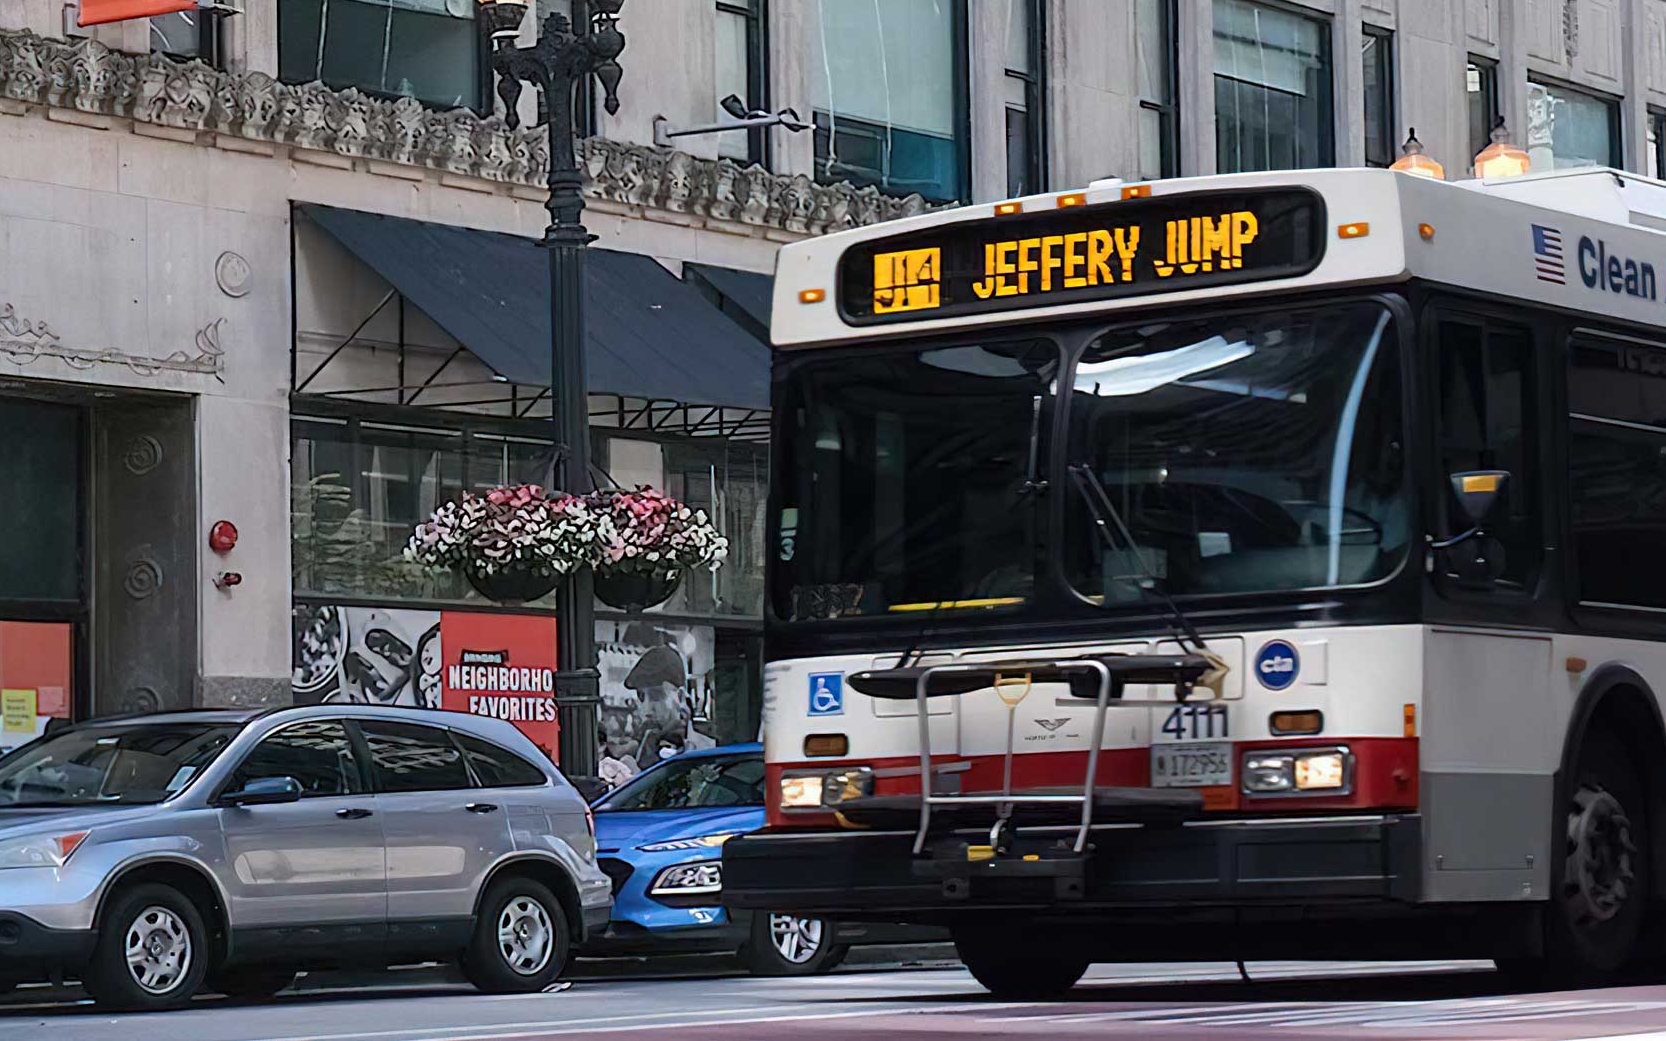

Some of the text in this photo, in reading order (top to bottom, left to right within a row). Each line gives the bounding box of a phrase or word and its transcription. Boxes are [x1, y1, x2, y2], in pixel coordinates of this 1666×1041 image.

[972, 225, 1140, 299] JEFFERY
[1153, 211, 1259, 278] JUMP
[1578, 235, 1657, 302] Clean
[449, 665, 553, 692] NEIGHBORHO
[469, 695, 558, 722] FAVORITES
[1162, 704, 1229, 740] 4111
